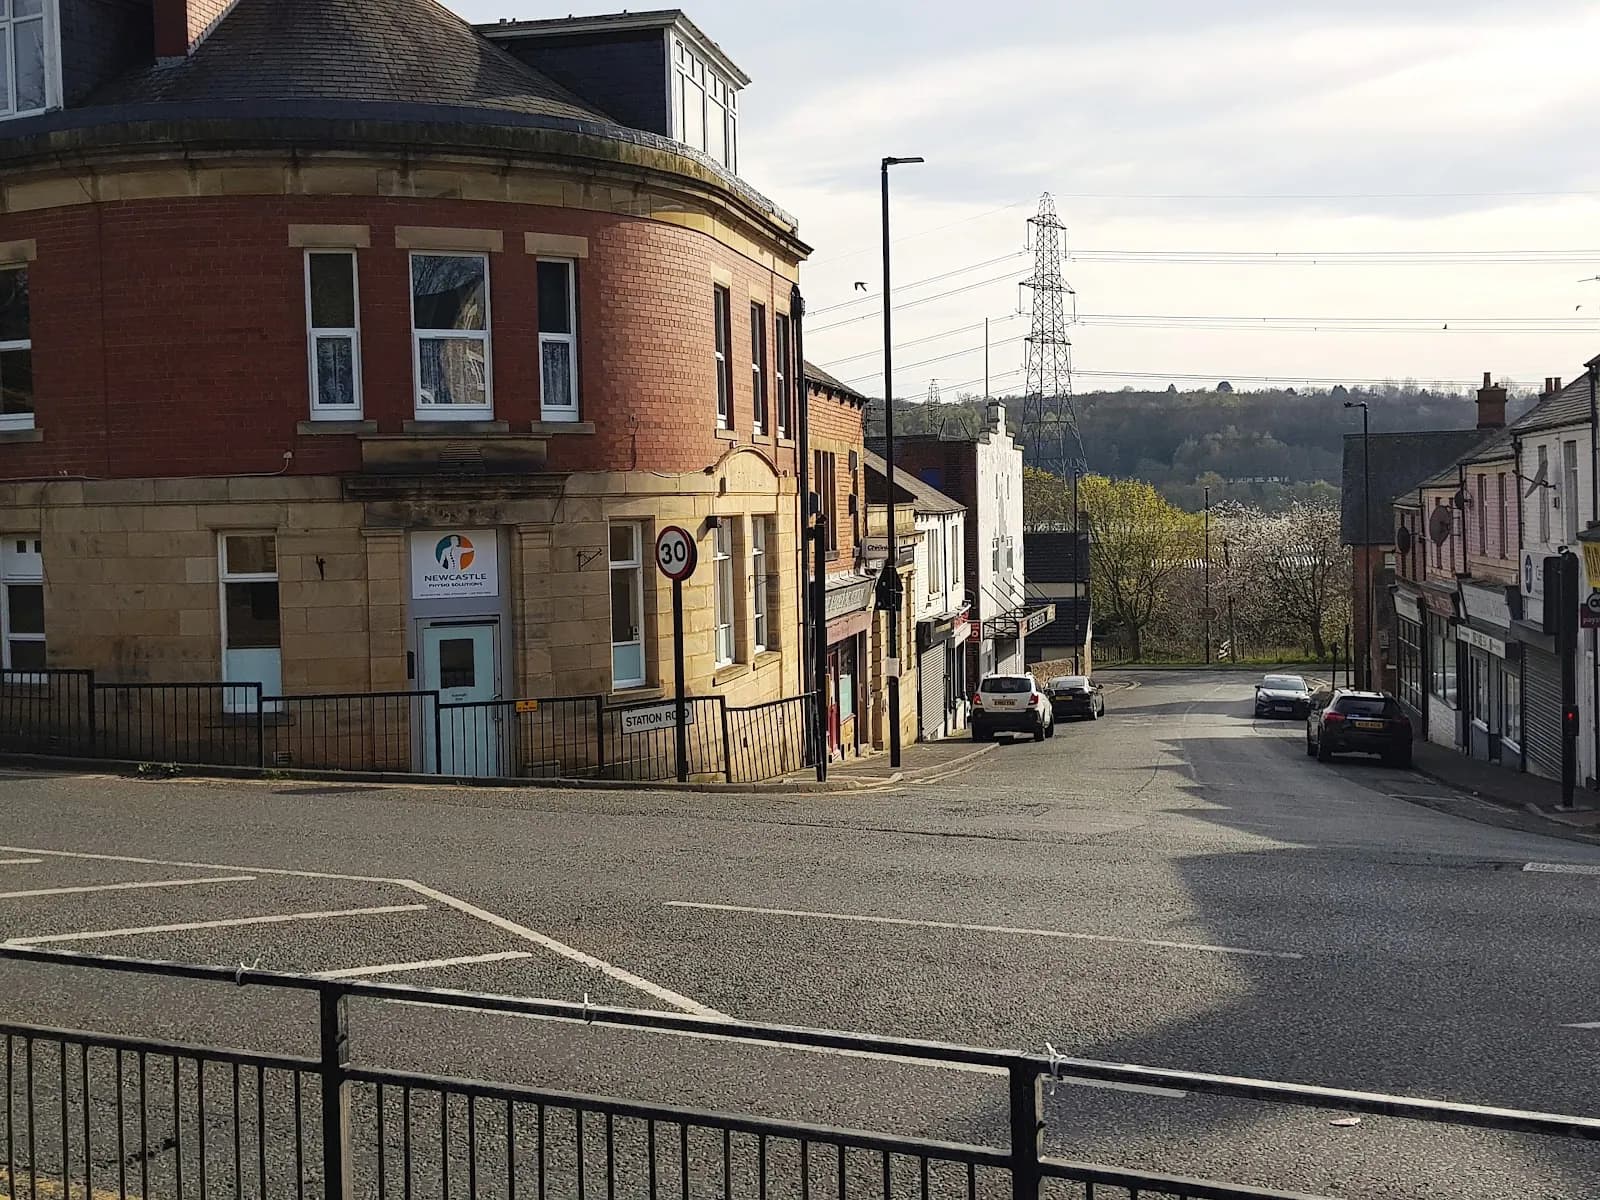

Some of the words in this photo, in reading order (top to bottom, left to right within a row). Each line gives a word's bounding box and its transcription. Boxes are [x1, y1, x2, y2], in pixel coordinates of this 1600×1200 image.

[660, 540, 686, 565] 30
[424, 573, 487, 582] NEWCASTLE
[626, 712, 662, 727] STATION
[665, 708, 690, 721] ROD
